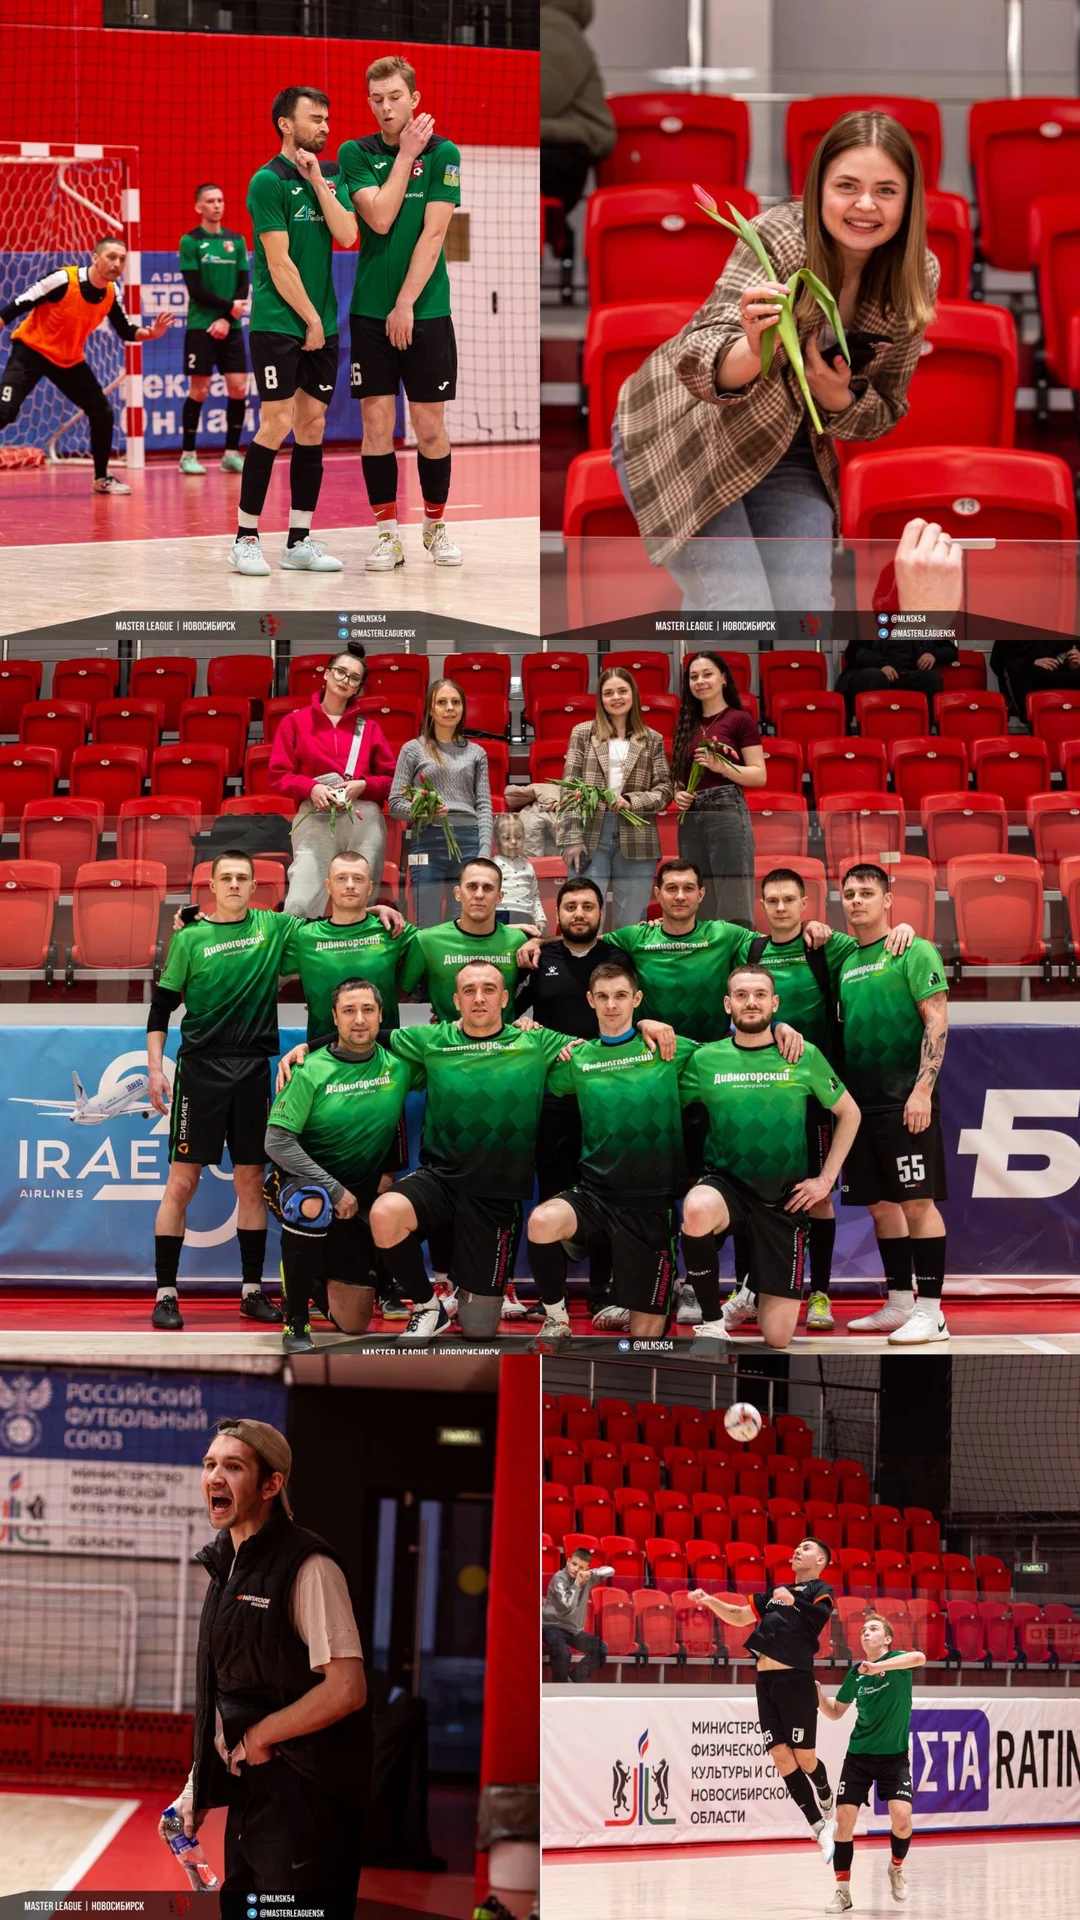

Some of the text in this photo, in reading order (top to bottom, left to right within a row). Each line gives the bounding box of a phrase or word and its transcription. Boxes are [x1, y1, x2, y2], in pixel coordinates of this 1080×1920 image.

[188, 354, 196, 369] 2
[264, 365, 278, 390] 8
[351, 362, 363, 386] 6
[1, 385, 13, 402] 9
[325, 1070, 391, 1096] Дивногорский
[714, 1067, 791, 1085] Дивногорский
[18, 1136, 235, 1180] IRAE
[896, 1154, 926, 1182] 55
[19, 1188, 84, 1199] AIRLINES
[66, 1382, 203, 1407] РОССИЙСКИЙ
[64, 1405, 209, 1432] ФУТБОЛЬНЫЙ
[63, 1428, 124, 1450] СОЮЗ
[691, 1721, 763, 1735] МИНИСТЕРС
[691, 1765, 781, 1779] КУЛЬТУРЫ И СП
[838, 1781, 846, 1796] 6
[690, 1810, 746, 1825] ОБЛАСТИ
